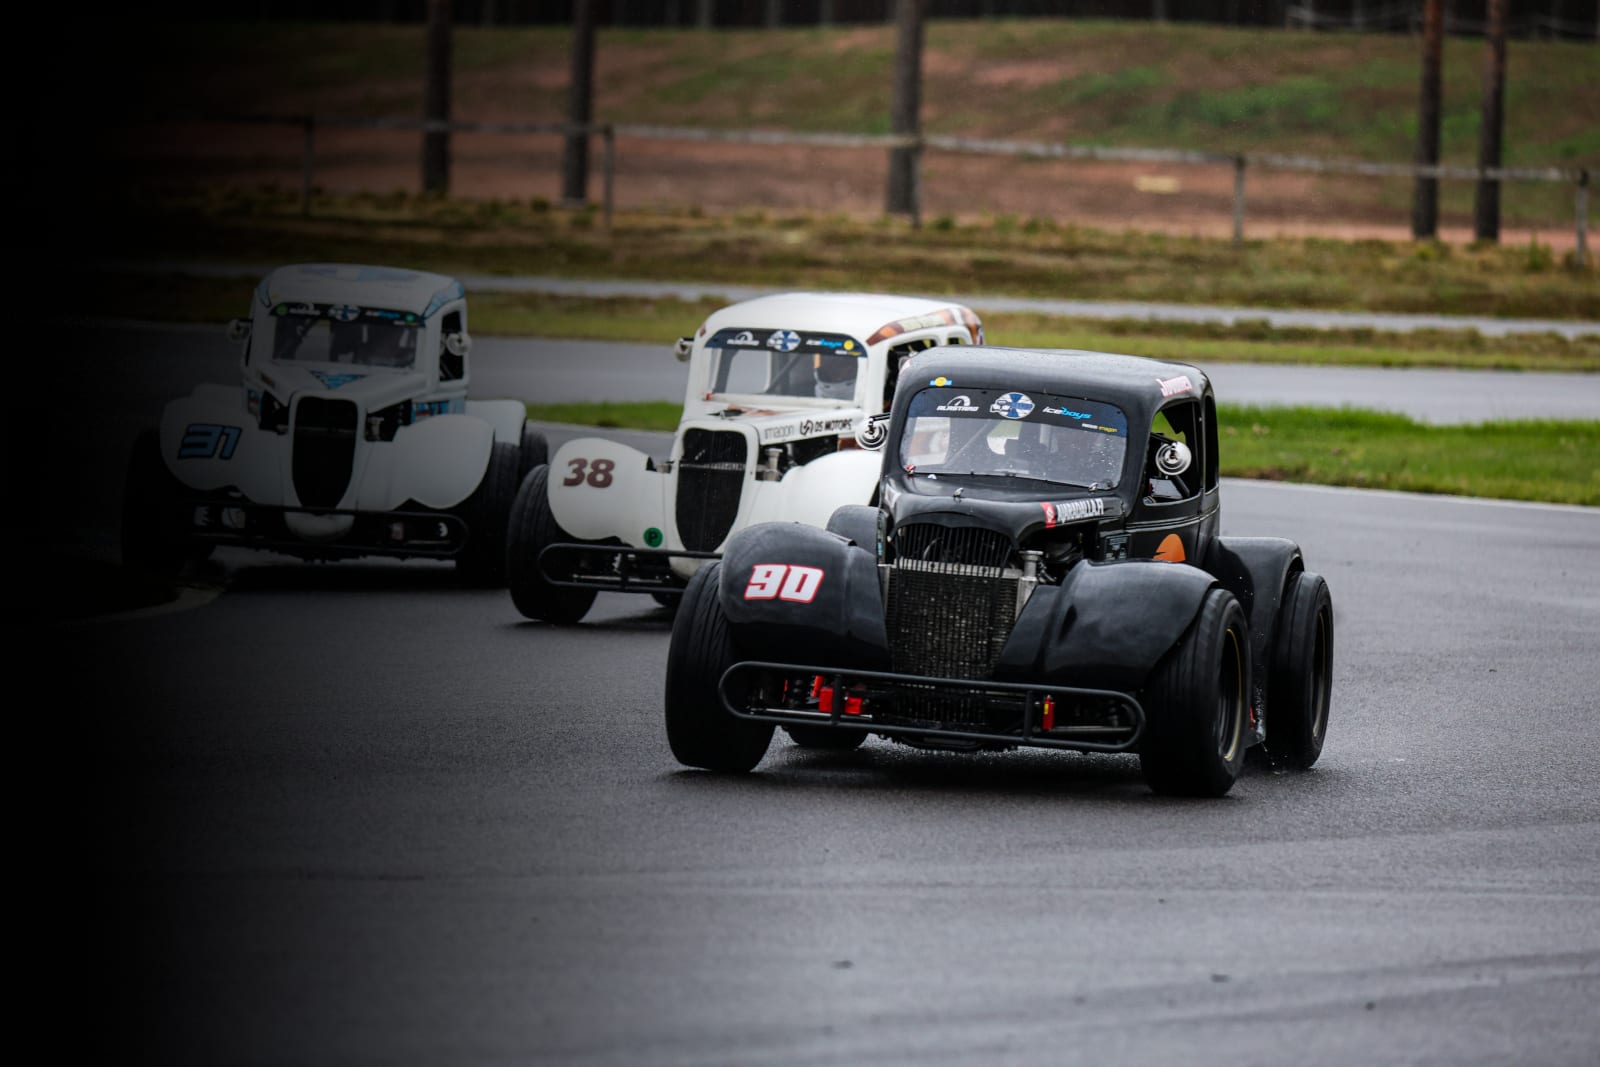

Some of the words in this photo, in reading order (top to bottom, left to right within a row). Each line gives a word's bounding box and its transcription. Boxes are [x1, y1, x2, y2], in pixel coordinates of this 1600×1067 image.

[1042, 406, 1093, 420] iceboys
[177, 423, 241, 459] 31
[563, 458, 615, 489] 38
[743, 563, 825, 604] 90
